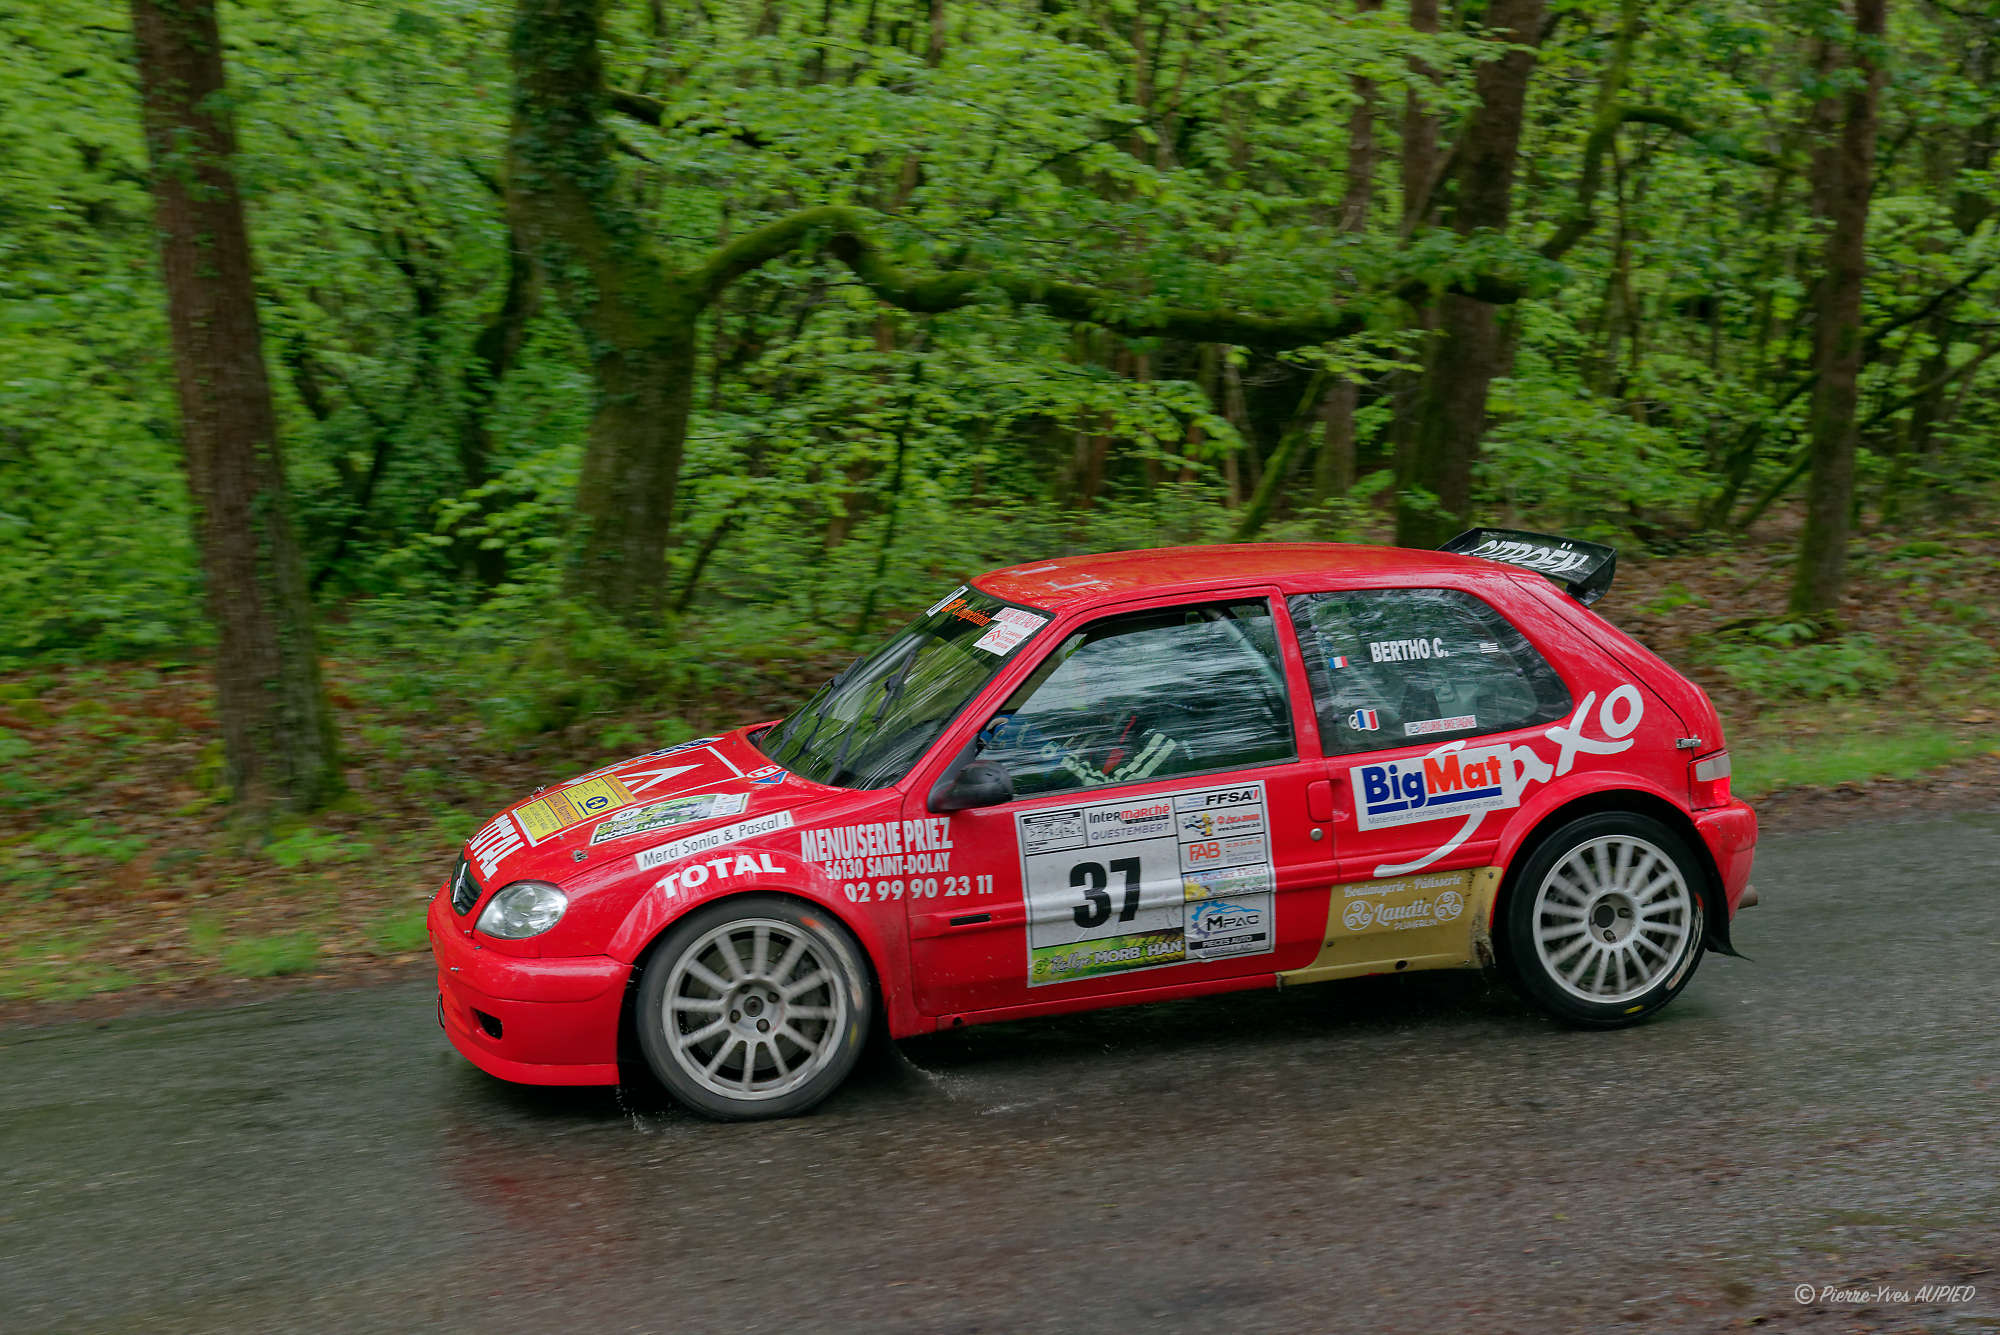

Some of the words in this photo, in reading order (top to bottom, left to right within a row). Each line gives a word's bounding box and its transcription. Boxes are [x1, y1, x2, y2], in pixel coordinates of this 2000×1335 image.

[1370, 638, 1431, 663] BERTHO
[1433, 637, 1450, 658] C.
[1361, 754, 1502, 809] BigMat
[1206, 790, 1252, 806] FFSA
[1088, 803, 1170, 824] Intermarché
[643, 846, 679, 868] Merci
[683, 832, 719, 855] Sonia
[724, 829, 735, 842] &
[738, 814, 779, 838] Pascal
[783, 812, 789, 826] !
[800, 821, 903, 863] MENUISERIE
[902, 817, 953, 853] PRIEZ
[1090, 822, 1170, 841] QUESTEMBERT
[468, 814, 526, 880] TOTAL
[1189, 841, 1221, 862] FAB
[656, 853, 787, 899] TOTAL
[825, 857, 864, 880] 56130
[866, 852, 951, 878] SAINT-DOLAY
[844, 882, 871, 903] 02
[876, 880, 905, 902] 99
[910, 878, 938, 899] 90
[943, 876, 971, 897] 23
[976, 874, 994, 894] 11
[1069, 856, 1141, 928] 37
[1344, 880, 1406, 898] Boulangerie
[1413, 875, 1462, 890] Pâtisserie
[1206, 915, 1259, 931] MPAC
[1374, 899, 1433, 927] Laudic
[1094, 940, 1184, 964] MORBHAN
